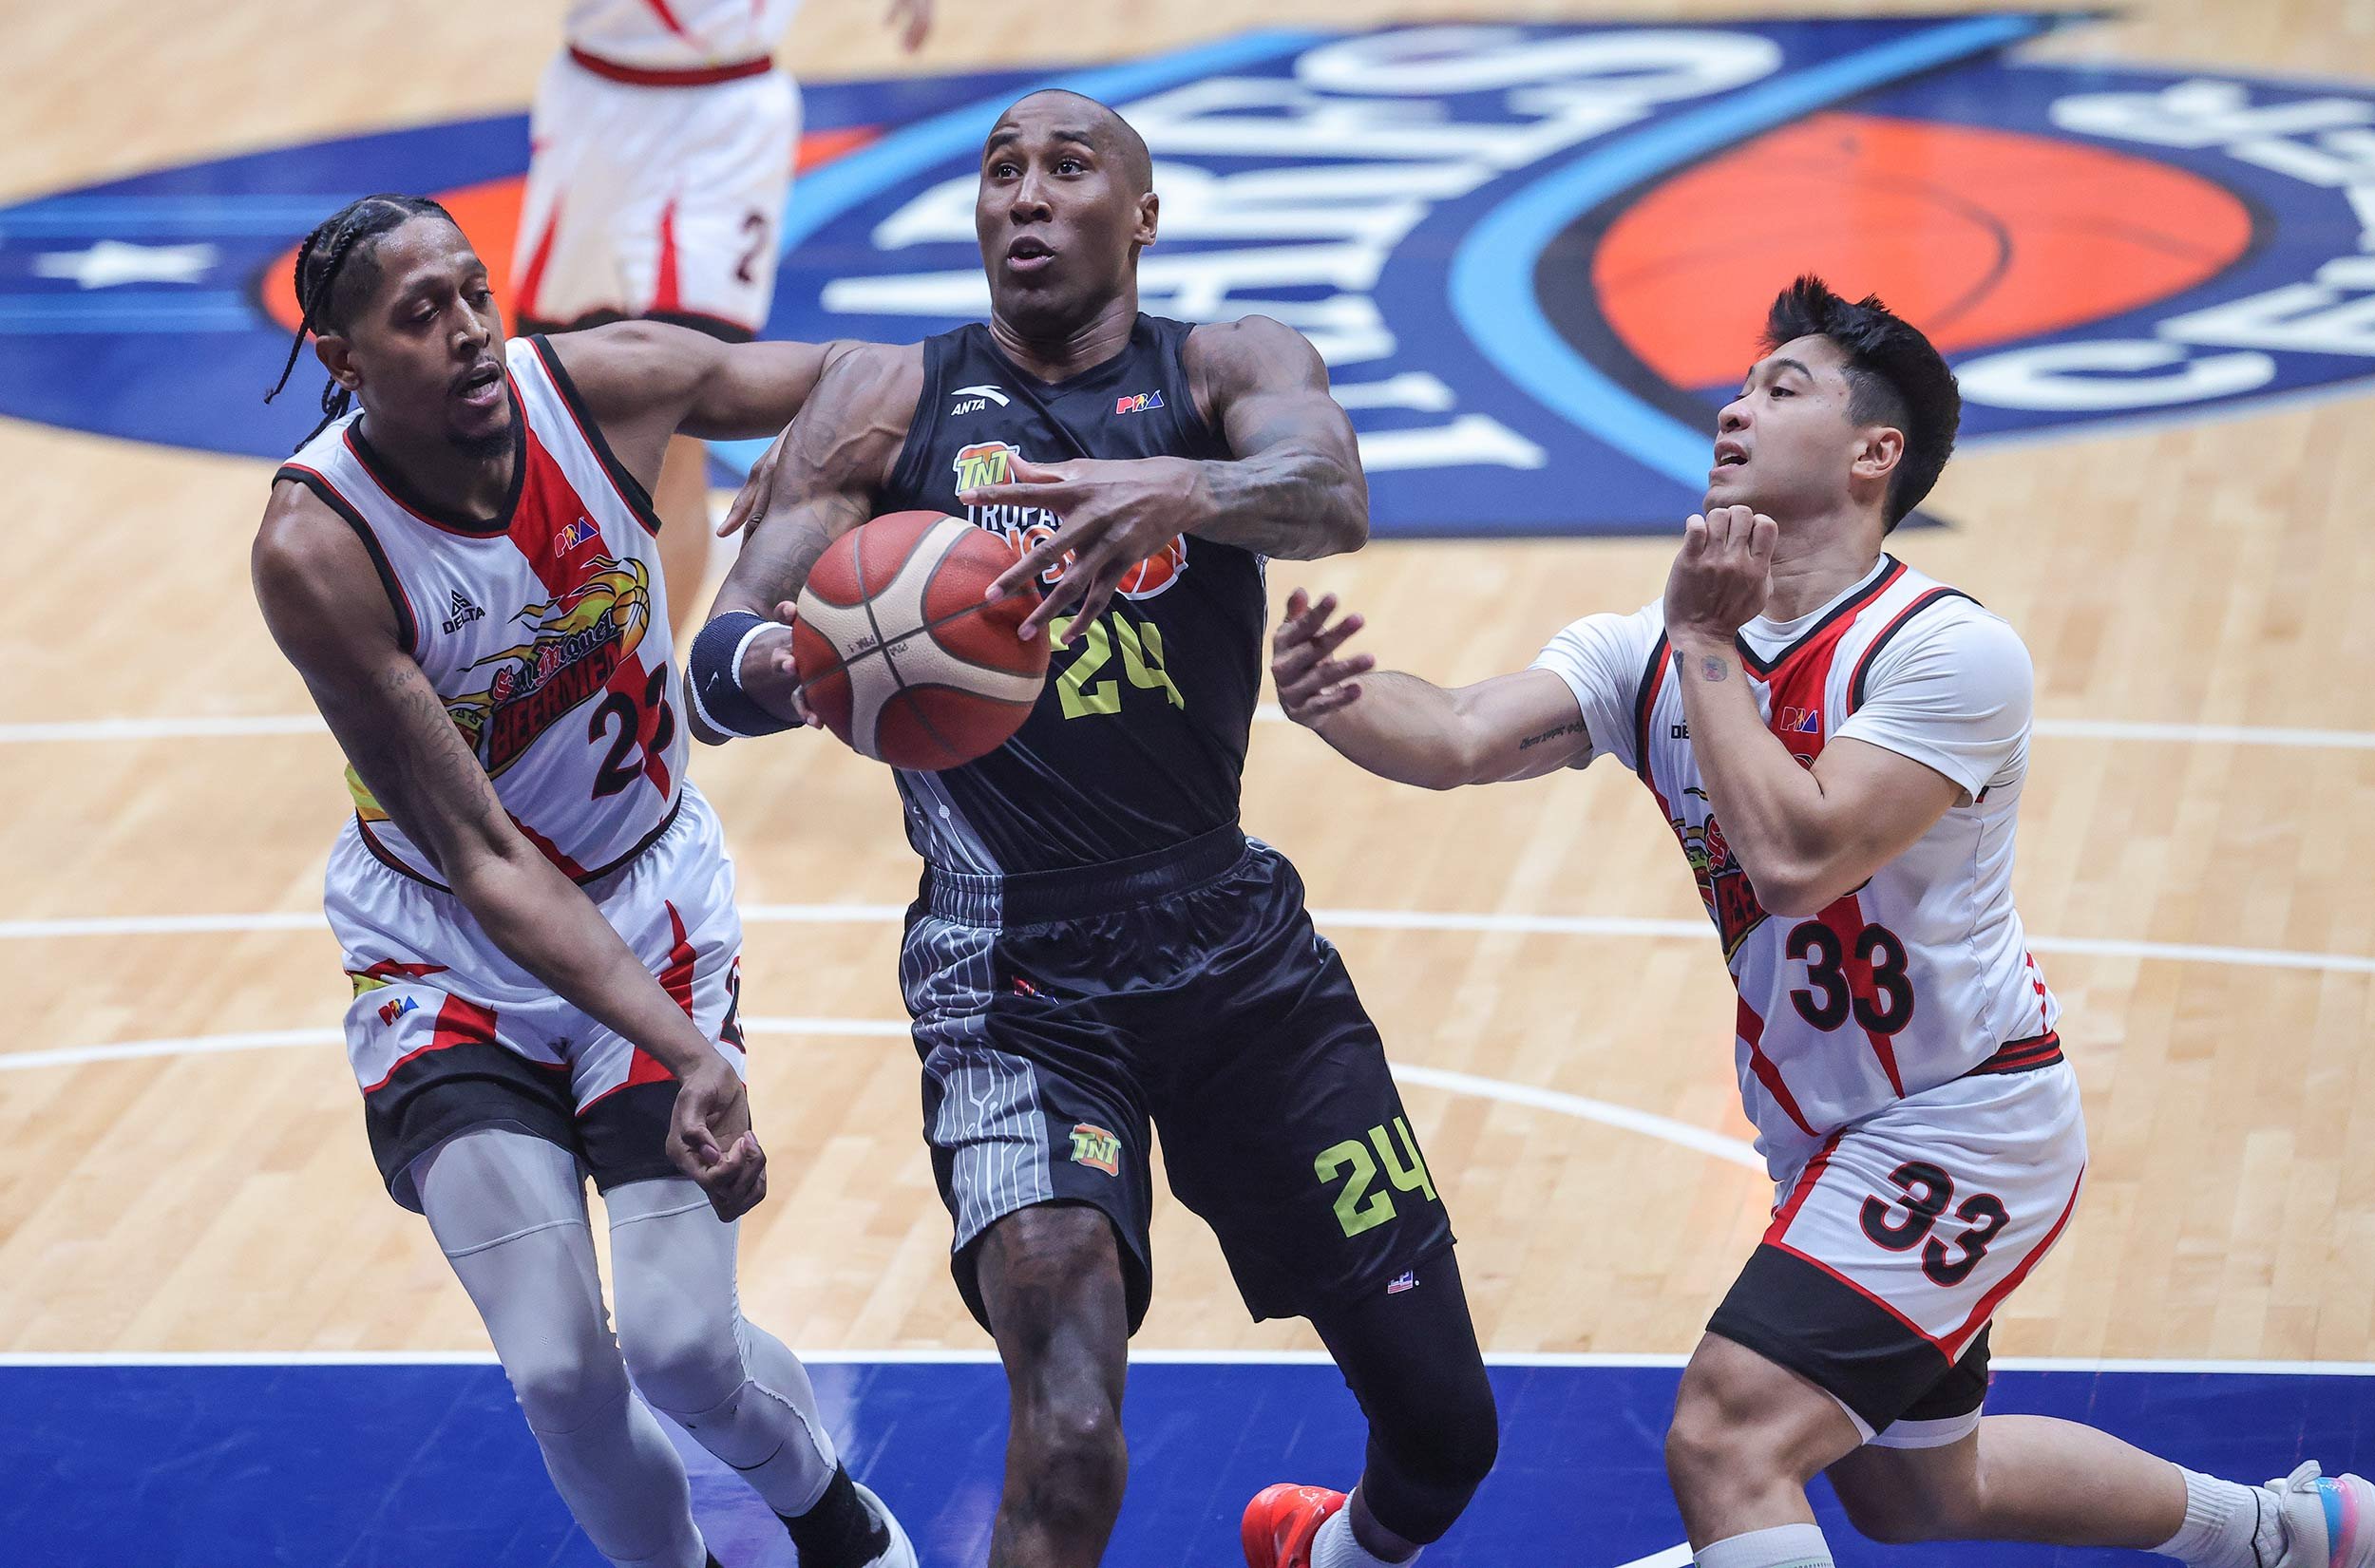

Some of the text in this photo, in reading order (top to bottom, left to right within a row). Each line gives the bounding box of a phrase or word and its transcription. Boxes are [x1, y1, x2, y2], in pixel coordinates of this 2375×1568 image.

[951, 398, 986, 416] ANTA
[1115, 389, 1164, 415] PBA
[957, 448, 1016, 491] TNT
[555, 516, 599, 557] PBA
[442, 606, 485, 634] DELTA
[1048, 609, 1185, 720] 24
[490, 634, 623, 767] BEERMEN
[1780, 705, 1819, 734] PBA
[1785, 918, 1915, 1035] 33
[378, 994, 420, 1028] PBA
[1070, 1131, 1121, 1165] TNT
[1313, 1115, 1437, 1238] 24
[1858, 1160, 2011, 1288] 33
